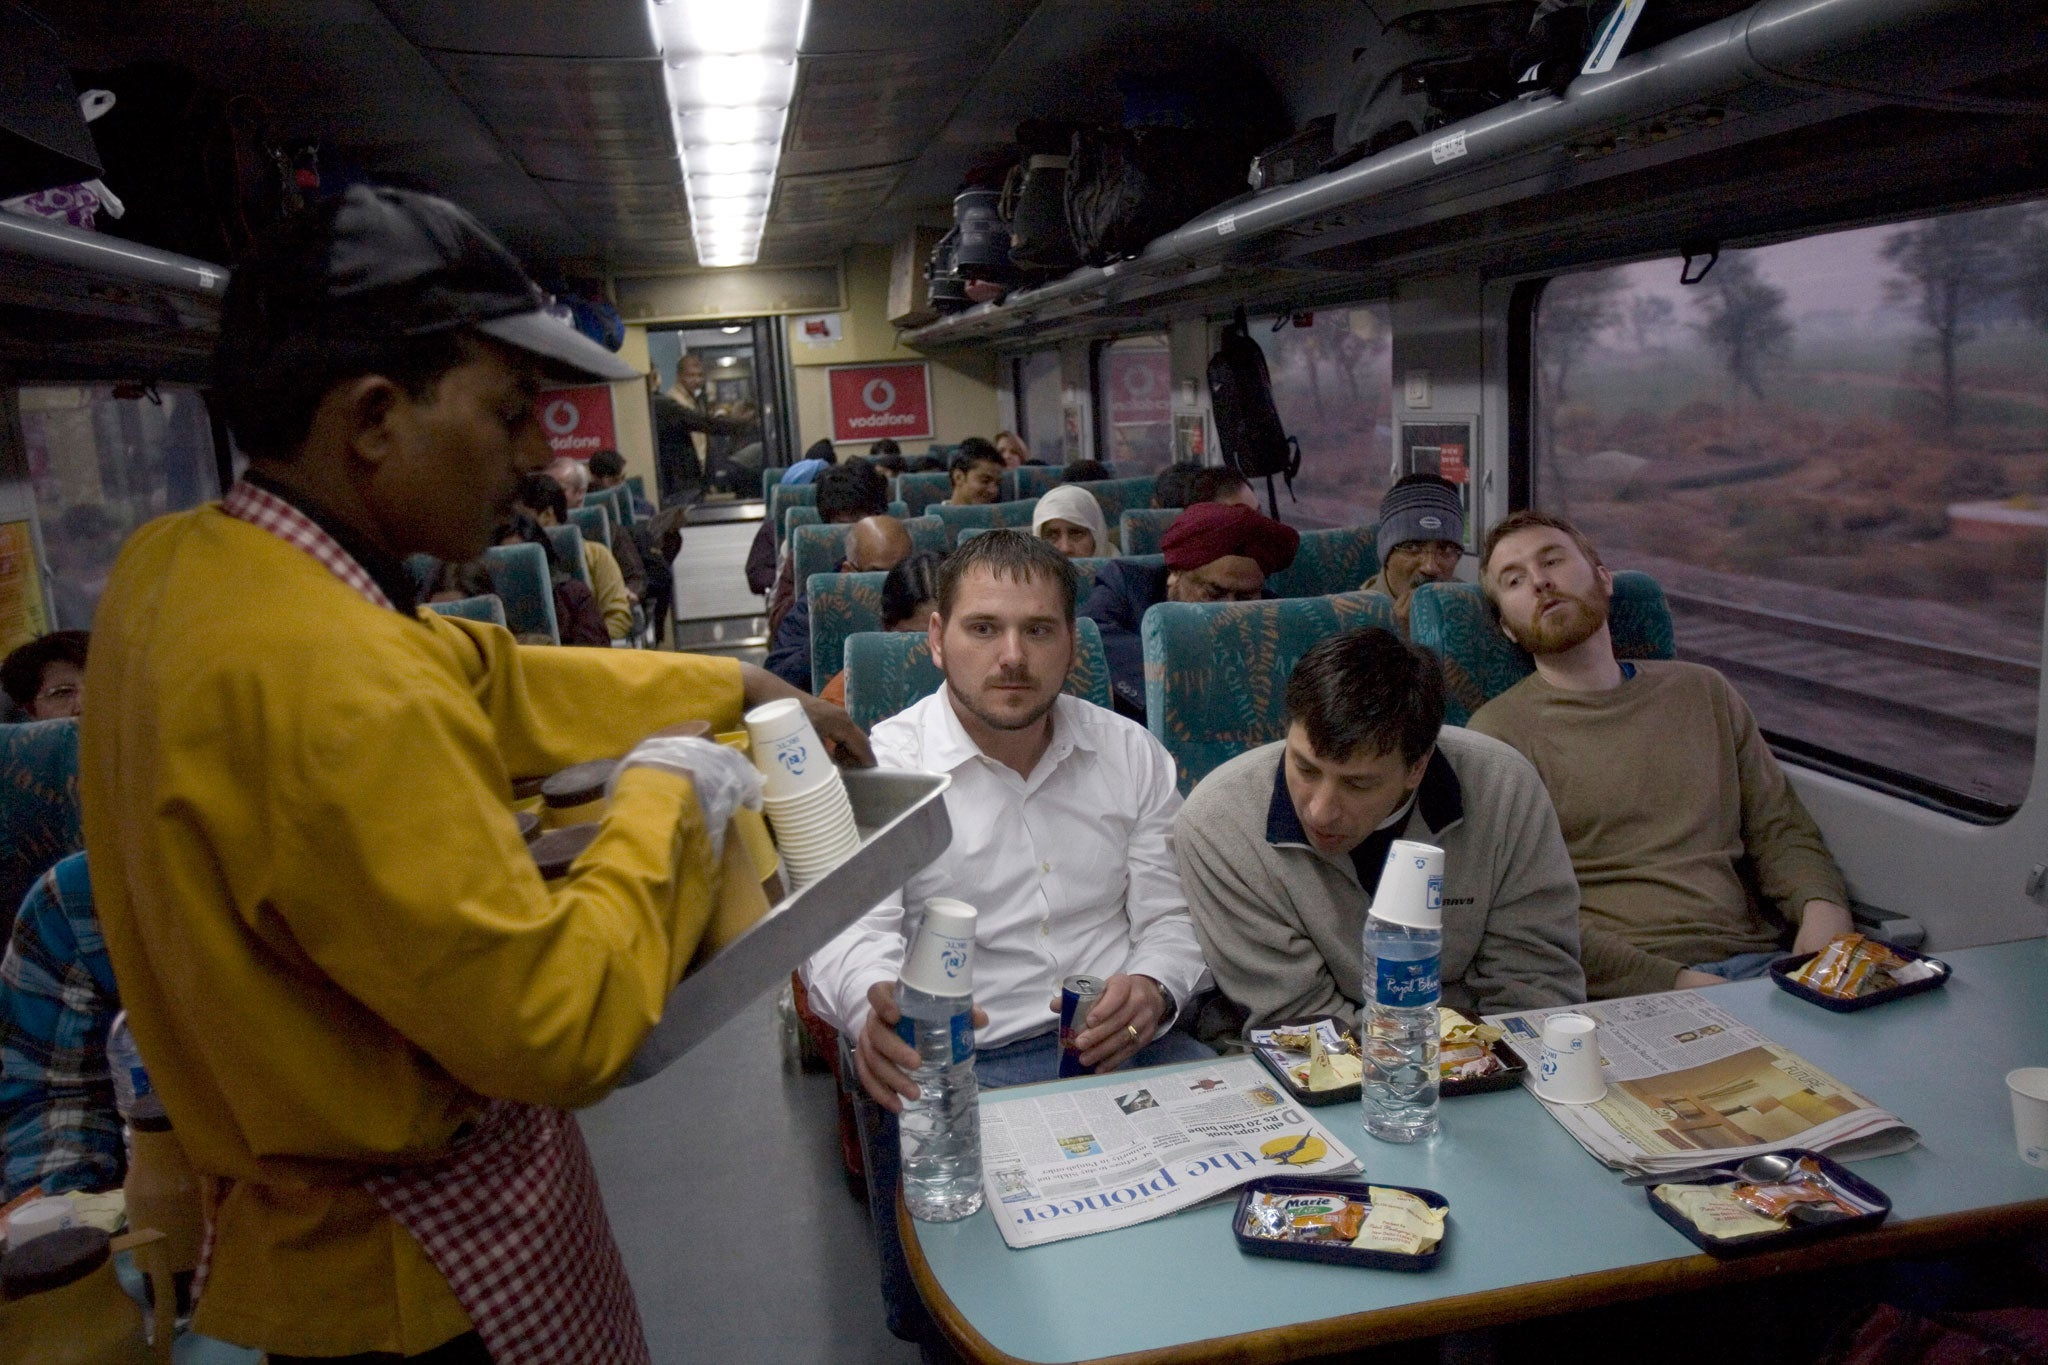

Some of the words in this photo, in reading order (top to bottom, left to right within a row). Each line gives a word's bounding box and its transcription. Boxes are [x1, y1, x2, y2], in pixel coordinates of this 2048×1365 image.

[849, 412, 915, 428] vodafone
[550, 434, 602, 451] dafone
[1387, 978, 1415, 1001] Royal
[1246, 1119, 1263, 1127] 20
[1262, 1114, 1279, 1123] Rs
[1187, 1125, 1218, 1134] bribe
[1219, 1122, 1246, 1131] lakh
[1234, 1126, 1261, 1137] cops
[1185, 1150, 1260, 1177] the
[1016, 1167, 1178, 1225] pioneer
[1284, 1198, 1330, 1210] Marie
